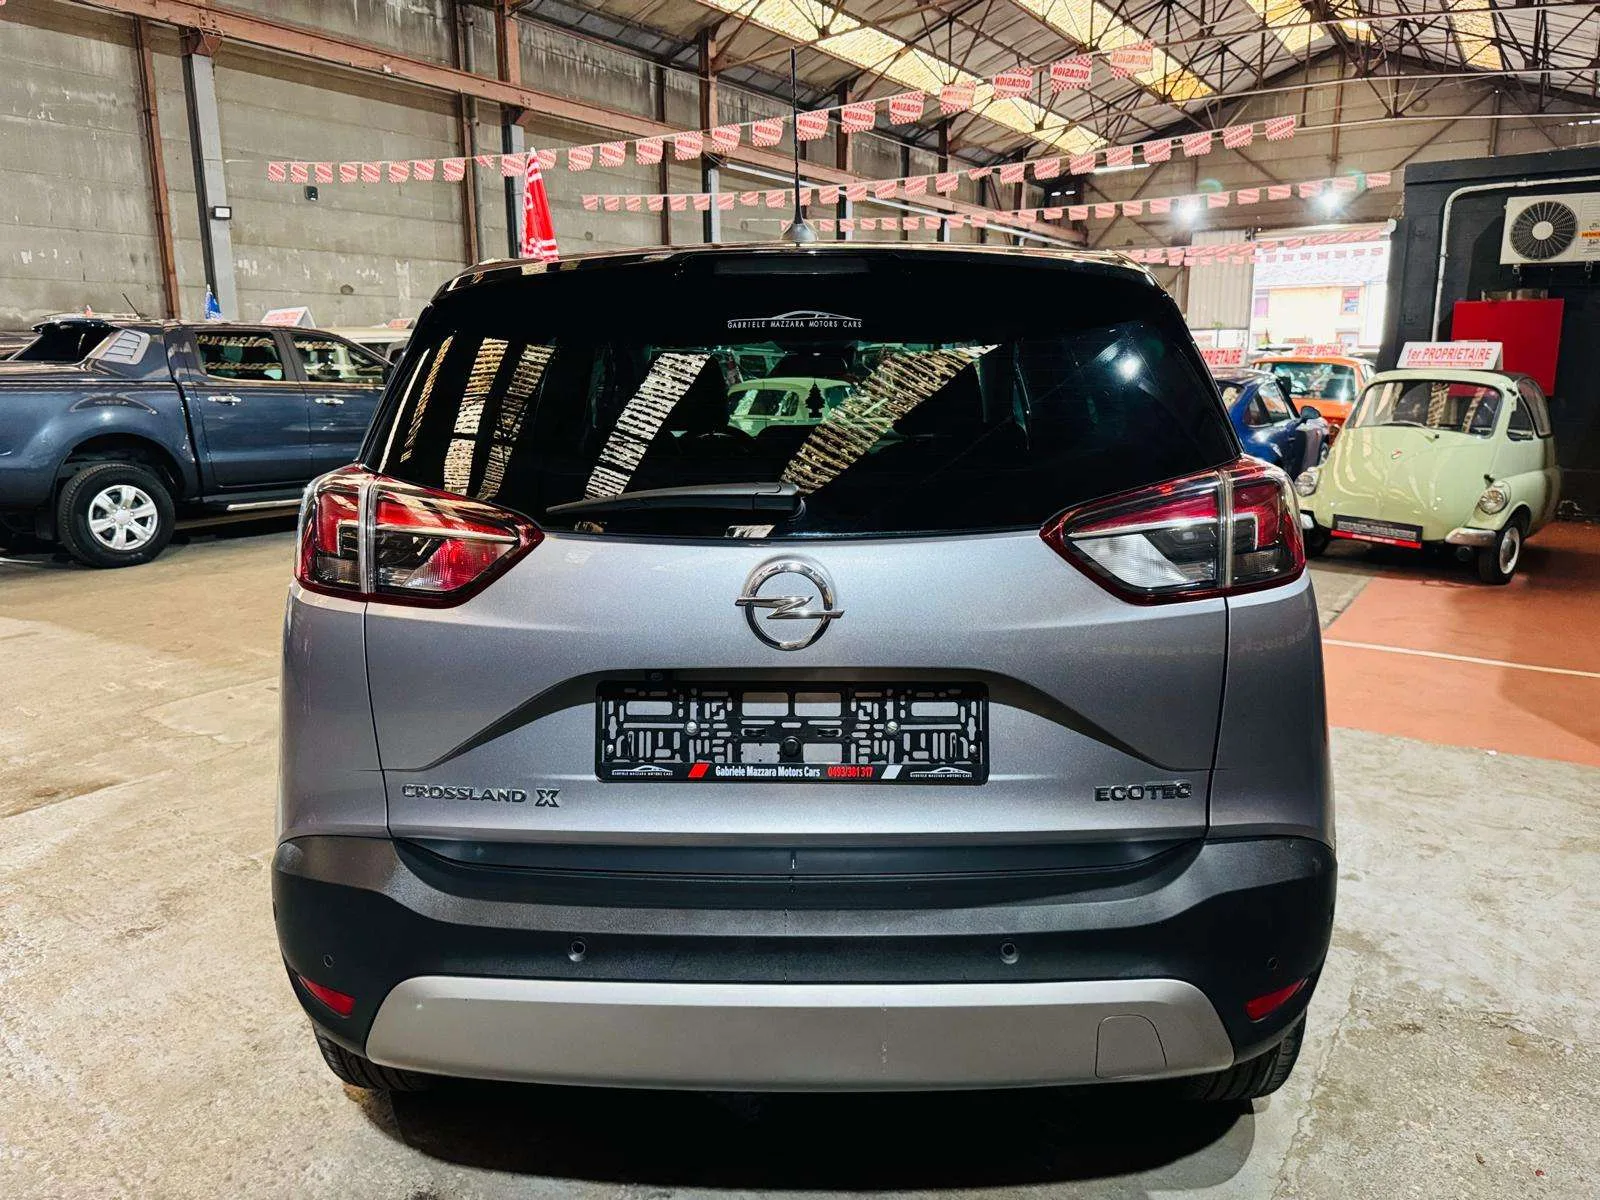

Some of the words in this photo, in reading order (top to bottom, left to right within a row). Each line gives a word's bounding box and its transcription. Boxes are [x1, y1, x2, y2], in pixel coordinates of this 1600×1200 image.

[727, 320, 766, 329] GABRIELE
[770, 320, 805, 328] MAZZARA
[808, 320, 838, 328] MOTORS
[843, 320, 862, 328] CARS
[1422, 347, 1493, 360] PROPRIETAIRE
[715, 765, 746, 777] Gabriele
[746, 765, 777, 777] Mazzara
[777, 766, 804, 777] Motors
[803, 767, 821, 777] Cars
[401, 782, 528, 803] CROSSLAND
[534, 788, 561, 808] X
[1094, 781, 1193, 801] ECOTEC
